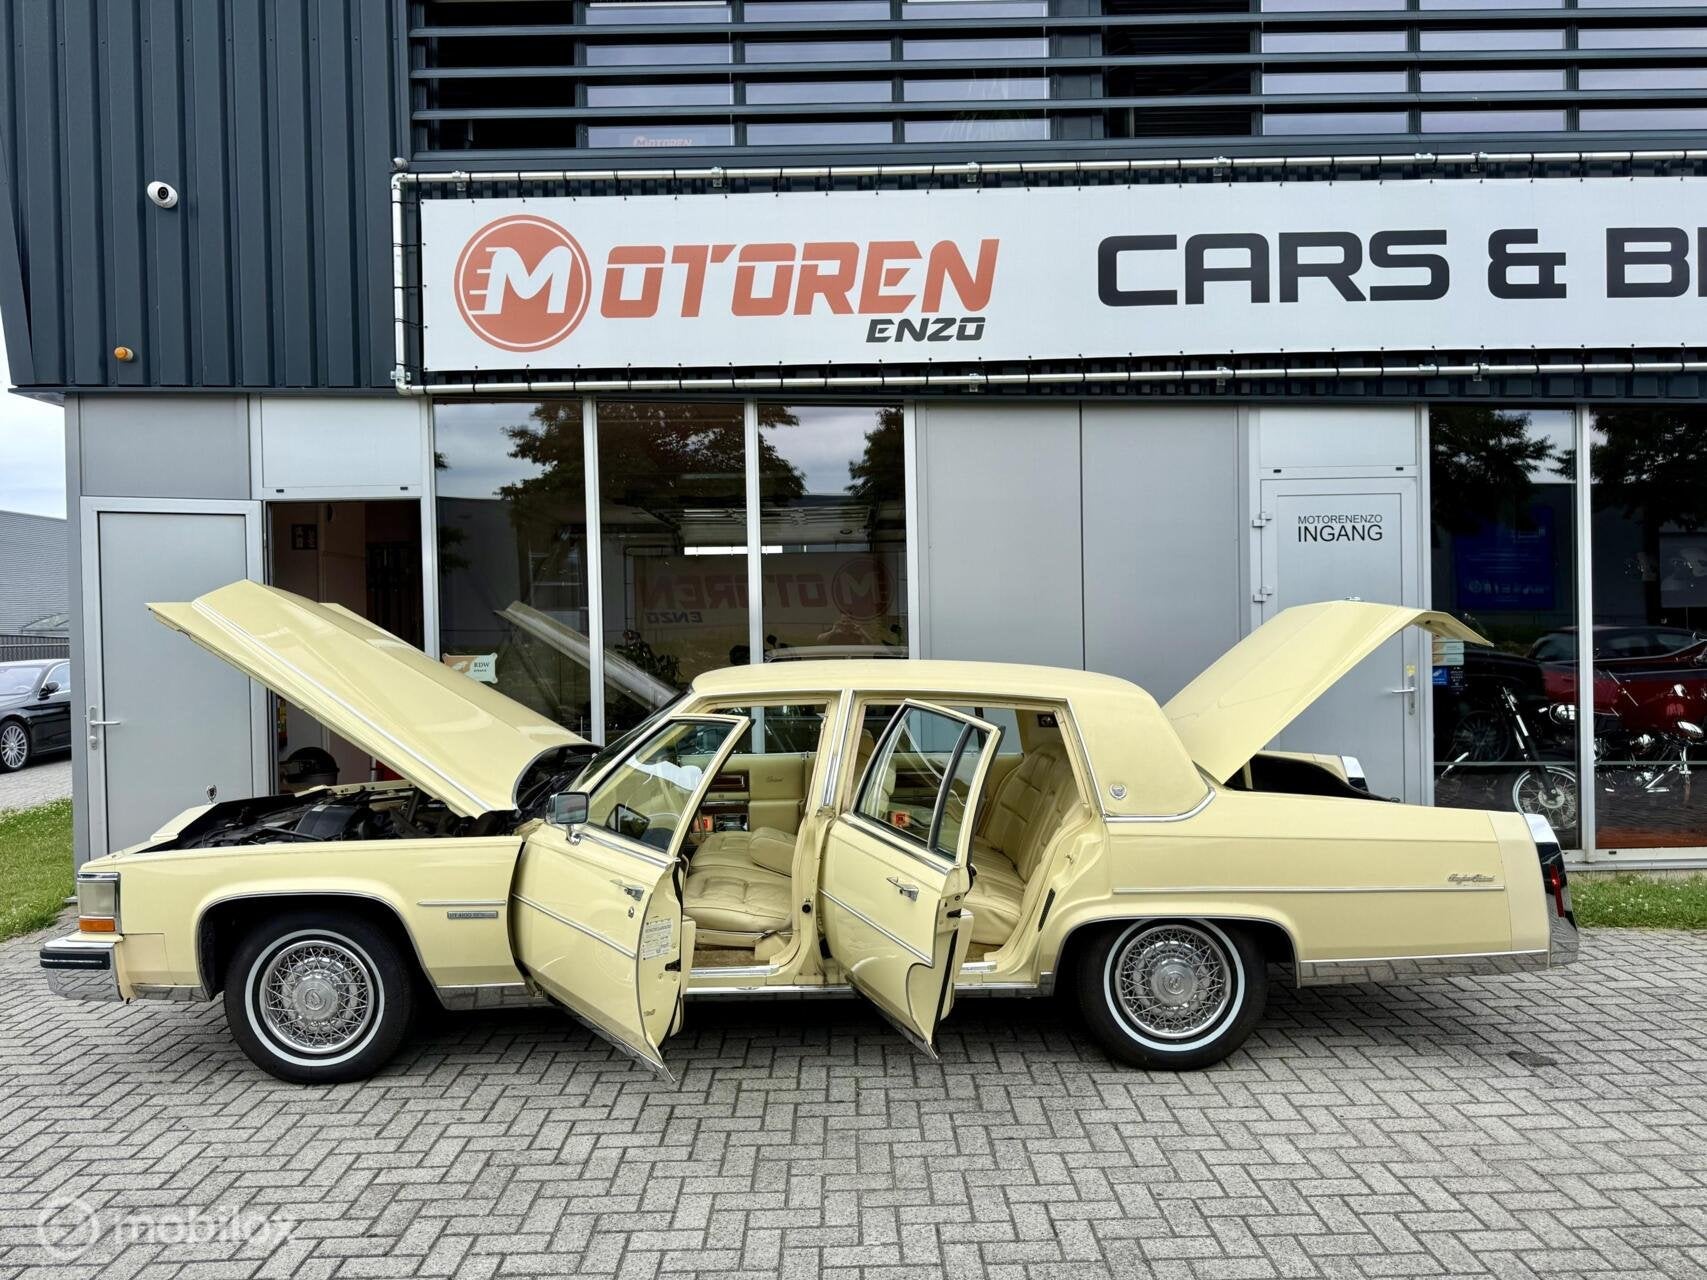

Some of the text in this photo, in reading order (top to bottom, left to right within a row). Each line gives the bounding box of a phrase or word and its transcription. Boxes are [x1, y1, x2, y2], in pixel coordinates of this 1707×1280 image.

[1098, 229, 1450, 307] CARS
[1488, 228, 1567, 299] &
[866, 316, 986, 343] ENZO
[1297, 514, 1383, 524] MOTORENENZO
[1297, 524, 1383, 542] INGANG
